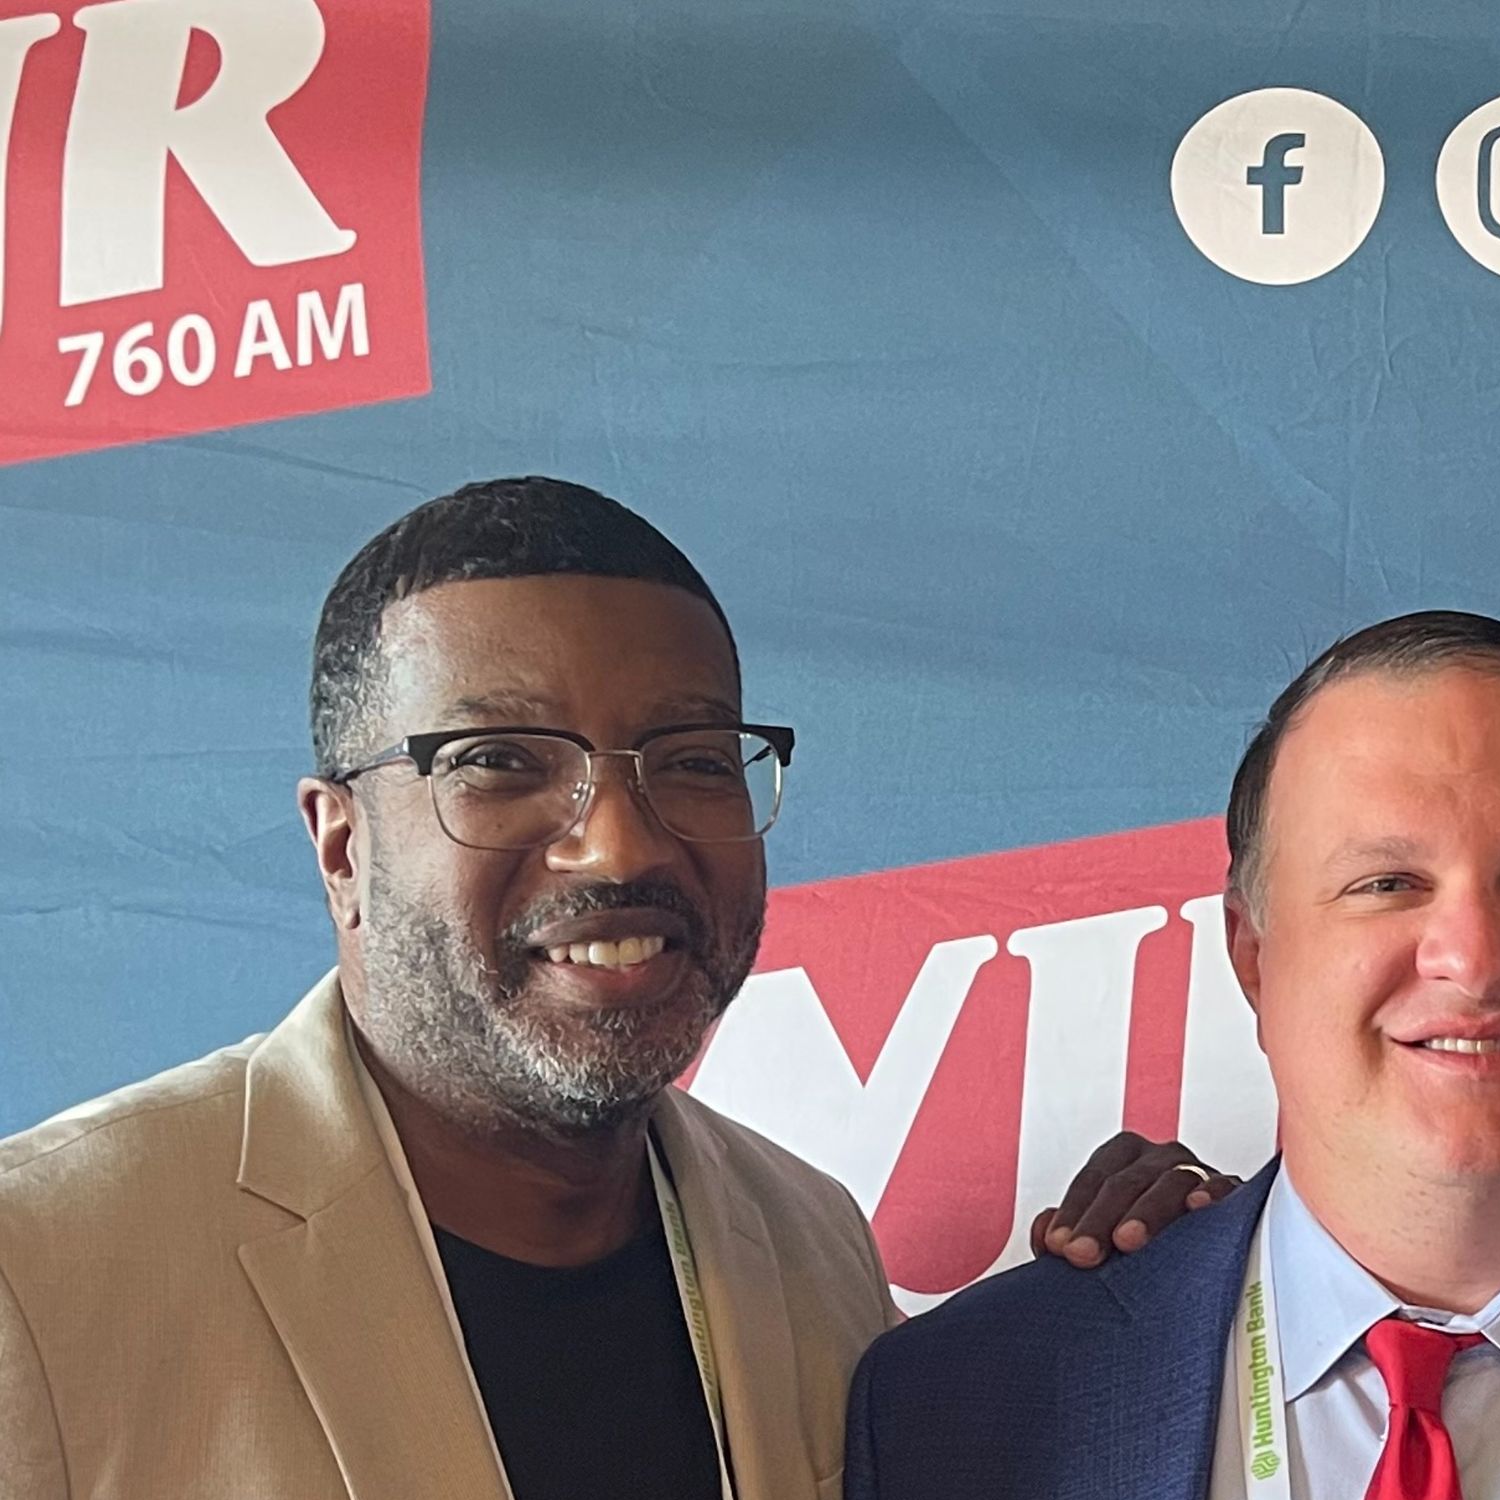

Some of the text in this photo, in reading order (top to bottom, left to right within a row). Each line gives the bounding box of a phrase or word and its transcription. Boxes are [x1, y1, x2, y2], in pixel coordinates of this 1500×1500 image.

[58, 282, 371, 407] 760 AM
[1245, 1281, 1274, 1449] Huntington Bank
